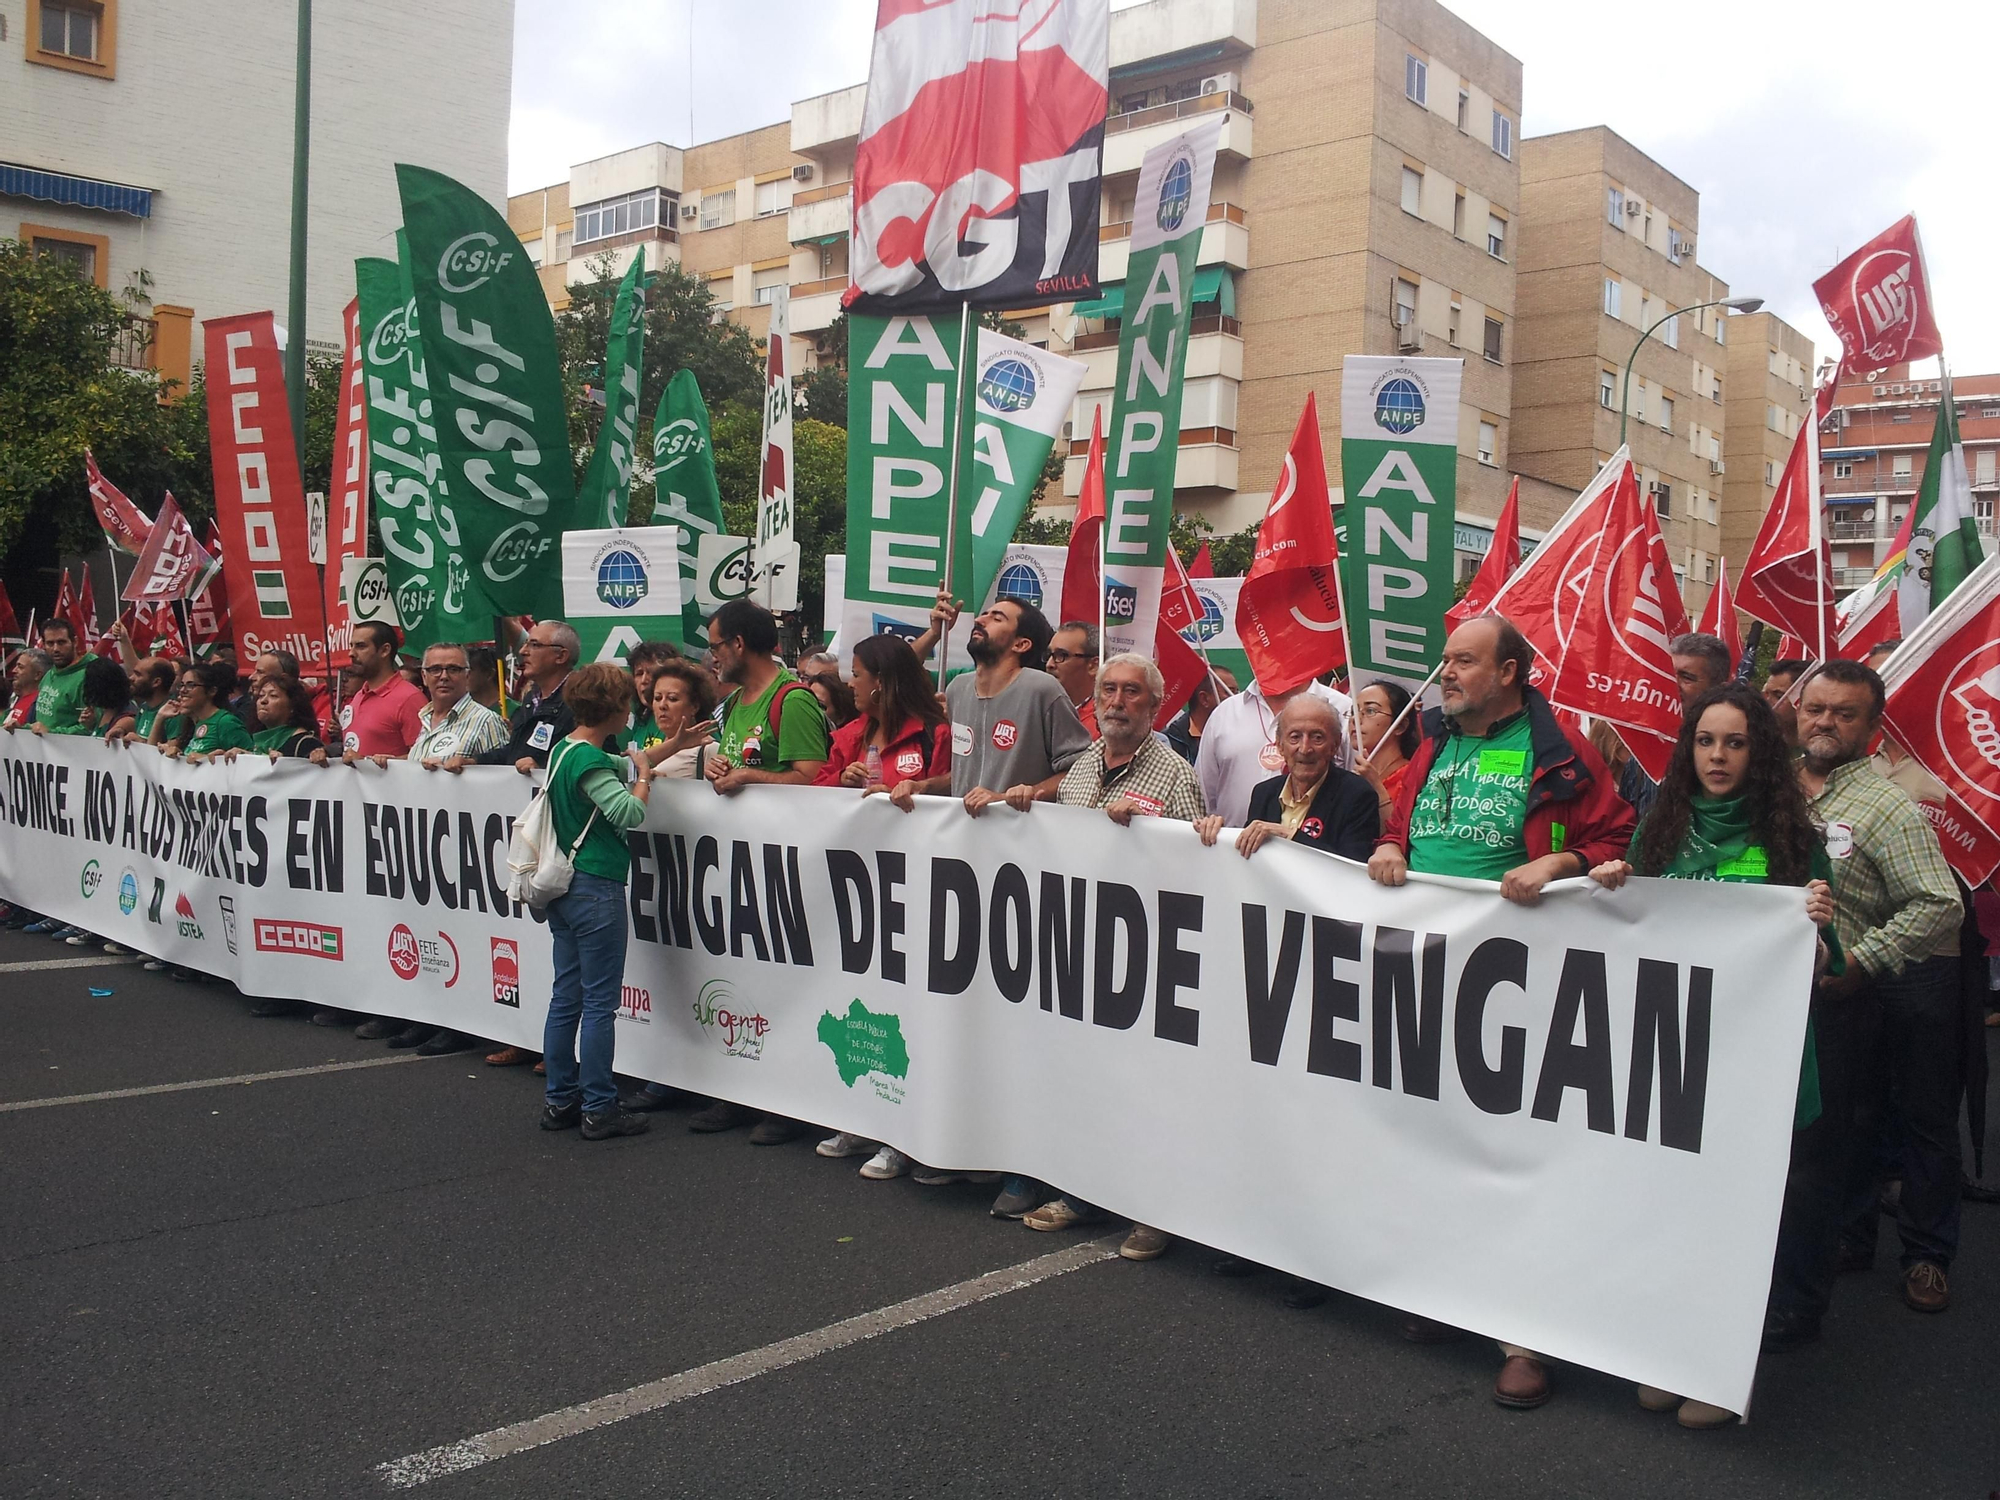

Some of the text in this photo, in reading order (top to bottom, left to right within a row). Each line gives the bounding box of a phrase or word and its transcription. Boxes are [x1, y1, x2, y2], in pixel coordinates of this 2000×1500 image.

[853, 147, 1099, 297] CGT
[1035, 273, 1091, 294] SEVILLA
[980, 350, 1046, 390] SINDICATO INDEPENDIENTE
[1369, 368, 1431, 400] SINDICATO INDEPENDIENTE
[983, 386, 1029, 410] ANPE
[1106, 252, 1182, 555] ANPE
[1381, 409, 1421, 426] ANPE
[226, 331, 281, 562] CCOO
[863, 315, 956, 598] ANPE
[590, 539, 652, 572] SINDICATO INDEPENDIENTE
[1357, 450, 1437, 674] ANPE
[604, 584, 646, 598] ANPE
[1107, 588, 1134, 617] fses
[244, 633, 323, 662] Sevilla
[996, 722, 1015, 740] UGT
[897, 753, 920, 768] UGT
[1420, 798, 1440, 811] DE
[1451, 796, 1507, 817] TOD@S
[1451, 824, 1515, 848] TOD@S
[120, 895, 135, 910] ANPE
[260, 925, 322, 951] CCOO
[393, 931, 413, 951] UGT
[419, 939, 439, 956] FETE
[83, 769, 117, 846] NO
[122, 775, 136, 851] A
[139, 779, 175, 862] LOS
[286, 798, 344, 893] EN
[627, 830, 815, 967] ENGAN
[825, 848, 907, 985] DE
[928, 856, 1204, 1047] DONDE
[1241, 902, 1714, 1155] VENGAN
[421, 955, 450, 968] Enseñanza
[493, 971, 518, 985] Andalucía
[494, 983, 518, 1004] CGT
[847, 1020, 868, 1032] ESCUELA
[852, 1039, 860, 1048] DE
[847, 1054, 866, 1065] PARA
